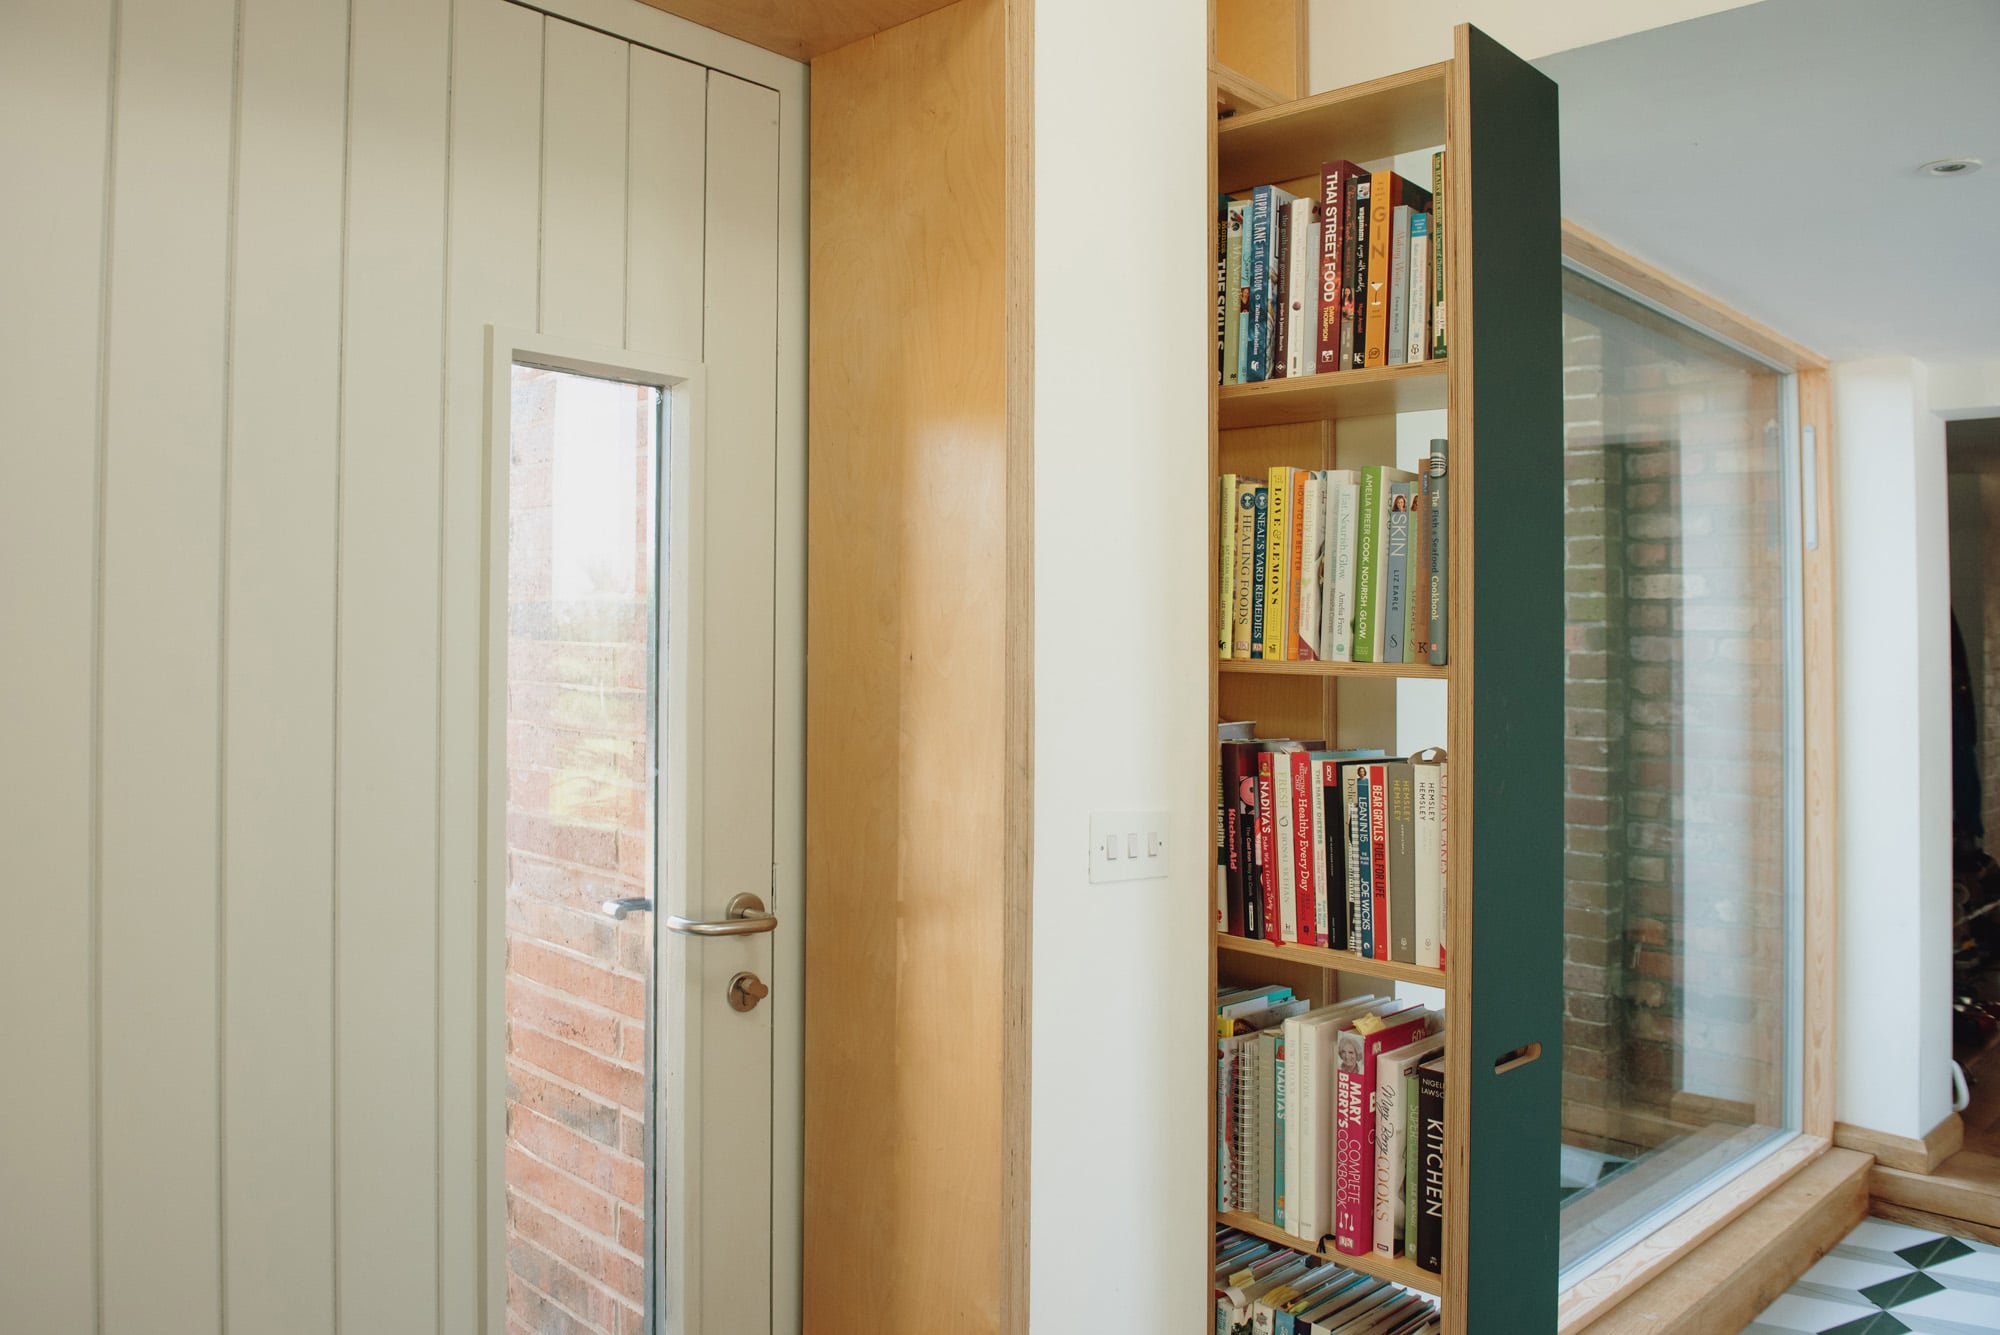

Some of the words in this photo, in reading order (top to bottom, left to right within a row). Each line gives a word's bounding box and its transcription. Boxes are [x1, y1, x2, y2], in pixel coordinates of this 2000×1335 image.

[1325, 171, 1338, 204] THAI
[1255, 192, 1268, 218] HIPPIE
[1253, 222, 1267, 245] LANE
[1324, 206, 1338, 260] STREET
[1357, 206, 1366, 242] wagamama
[1371, 206, 1386, 260] GIN
[1254, 246, 1264, 258] THE
[1254, 260, 1264, 292] COOKBOOK
[1323, 262, 1337, 303] FOOD
[1273, 487, 1282, 527] LOVE
[1432, 489, 1440, 507] The
[1257, 512, 1266, 550] NEAL'S
[1297, 510, 1303, 520] TO
[1364, 508, 1372, 535] FREER
[1431, 510, 1440, 528] Fish
[1241, 514, 1252, 576] HEALING
[1272, 529, 1282, 540] &
[1391, 513, 1407, 557] SKIN
[1255, 552, 1265, 582] YARD
[1295, 540, 1303, 571] BETTER
[1431, 538, 1439, 573] Seafood
[1271, 542, 1281, 605] LEMONS
[1360, 566, 1369, 609] NOURISH.
[1238, 580, 1250, 625] FOODS
[1253, 584, 1264, 638] REMEDIES
[1338, 592, 1346, 617] Amelia
[1391, 585, 1399, 612] EARLE
[1431, 576, 1440, 621] Cookbook
[1337, 617, 1345, 635] Freer
[1359, 610, 1367, 640] GLOW.
[1278, 771, 1288, 808] FRESH
[1298, 763, 1306, 798] MEDICINAL
[1372, 784, 1383, 808] BEAR
[1259, 780, 1272, 834] NADIYA'S
[1359, 796, 1368, 820] LEAN
[1393, 779, 1401, 822] HEMSLEY
[1402, 779, 1410, 822] HEMSLEY
[1297, 798, 1309, 839] Healthy
[1360, 822, 1368, 832] IN
[1373, 808, 1384, 842] GRYLLS
[1228, 808, 1238, 871] KitchenAid
[1281, 833, 1289, 863] DONAL
[1360, 833, 1368, 842] 15
[1374, 843, 1385, 864] FUEL
[1298, 840, 1309, 870] Every
[1298, 871, 1310, 891] Day
[1360, 878, 1370, 898] JOE
[1374, 864, 1385, 880] FOR
[1375, 881, 1385, 899] LIFE
[1361, 899, 1371, 930] WICKS
[1421, 1087, 1444, 1099] LAWSO
[1422, 1078, 1444, 1089] NIGEL
[1338, 1072, 1349, 1129] BERRY'S
[1349, 1080, 1362, 1126] MARY
[1376, 1085, 1396, 1121] Mary
[1376, 1122, 1394, 1156] Berry
[1337, 1129, 1349, 1209] COOKBOOK
[1347, 1139, 1361, 1205] COMPLETE
[1426, 1118, 1444, 1218] KITCHEN
[1376, 1155, 1391, 1222] COOKS
